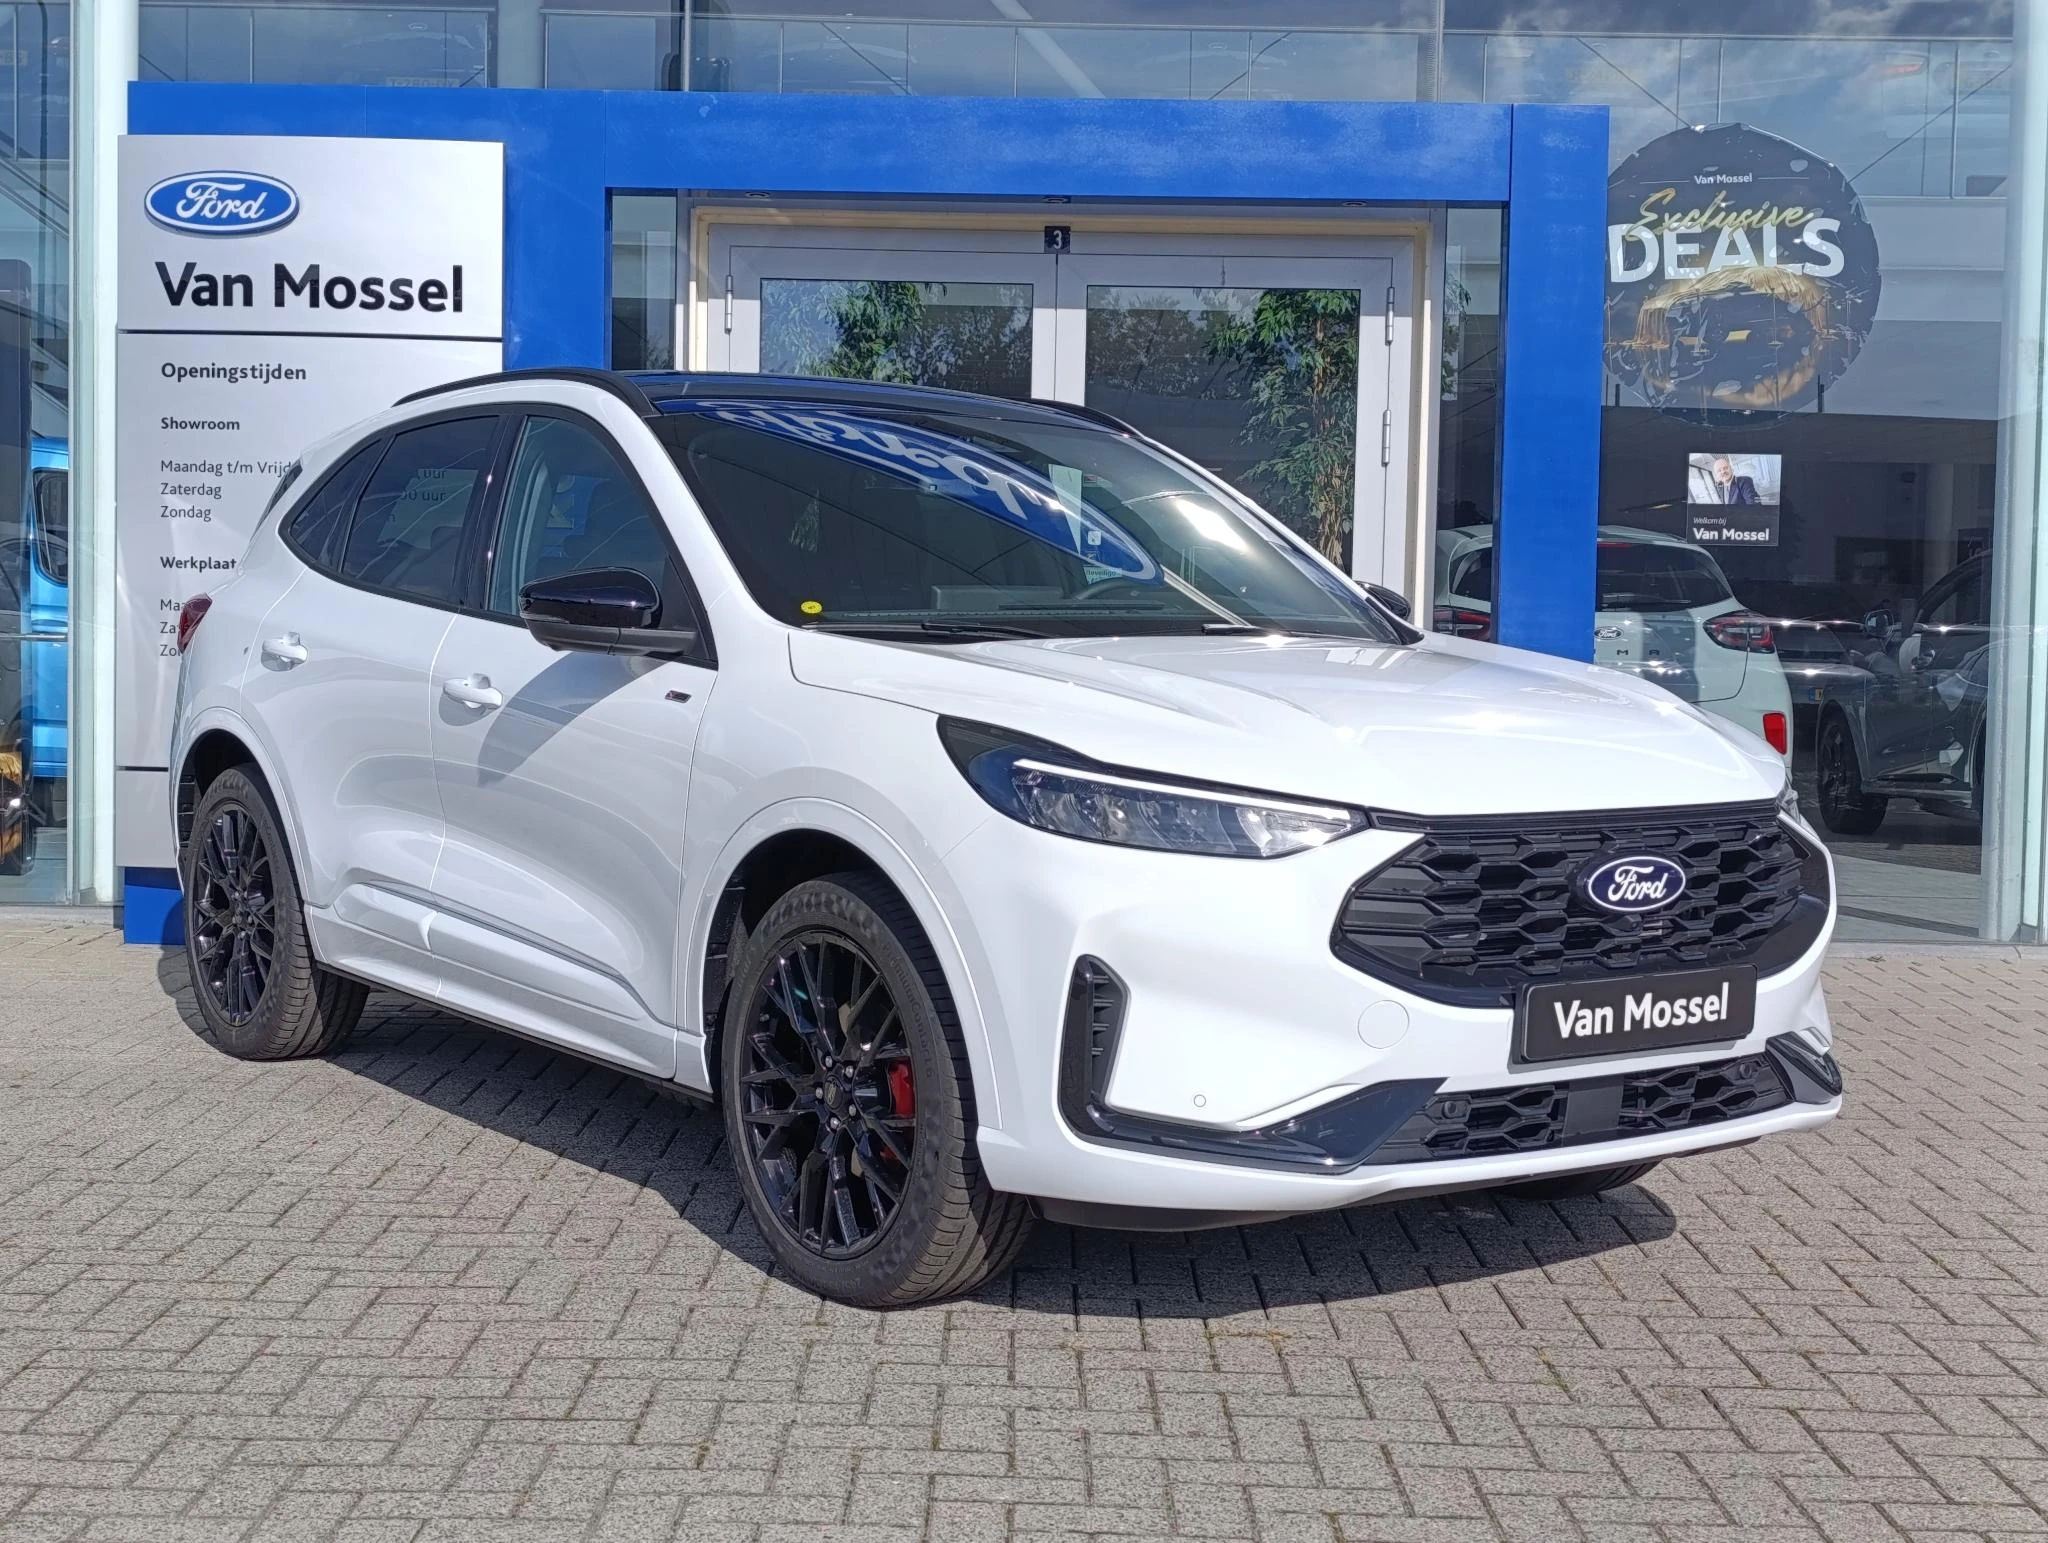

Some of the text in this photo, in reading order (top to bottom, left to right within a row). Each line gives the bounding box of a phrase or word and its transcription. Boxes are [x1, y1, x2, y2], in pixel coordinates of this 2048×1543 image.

[1693, 172, 1753, 185] Van Mossel
[176, 181, 267, 220] Ford
[1625, 187, 1817, 242] Exclusive
[1053, 229, 1062, 250] 3
[1607, 217, 1845, 283] DEALS
[155, 261, 463, 312] Van Mossel
[160, 362, 307, 384] Openingstijden
[160, 416, 240, 431] Showroom
[160, 459, 223, 477] Maandag
[227, 460, 253, 474] t/m
[160, 482, 222, 500] Zaterdag
[160, 505, 212, 522] Zondag
[1693, 528, 1770, 541] Van Mossel
[159, 555, 237, 573] Werkplaat
[160, 599, 184, 611] Ma
[159, 621, 178, 634] Za
[1607, 865, 1668, 902] Ford
[1553, 982, 1730, 1038] Van Mossel
